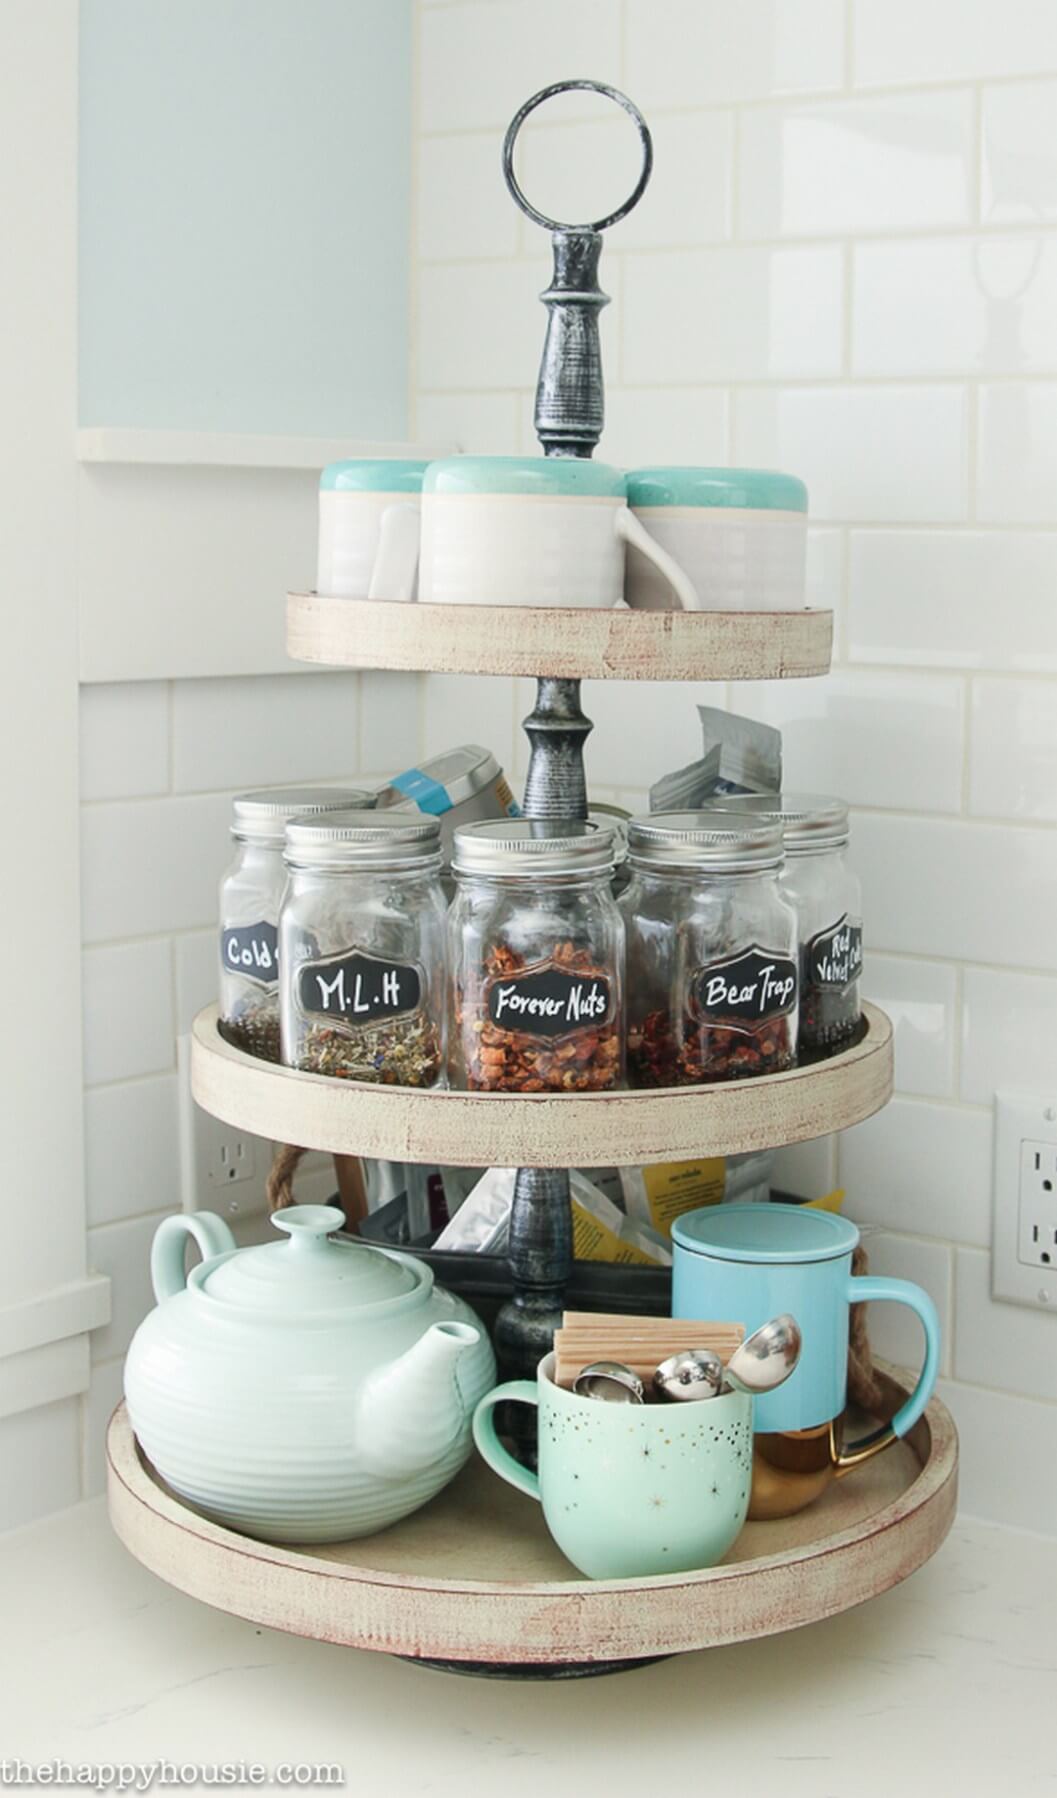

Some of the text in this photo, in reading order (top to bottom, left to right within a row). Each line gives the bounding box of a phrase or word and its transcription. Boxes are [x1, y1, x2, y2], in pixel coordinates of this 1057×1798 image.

[227, 937, 272, 968] Cold
[831, 927, 850, 959] Red
[315, 968, 400, 1013] M.L.H
[495, 984, 606, 1021] Forever Nuts
[705, 964, 794, 1012] Bear Trap
